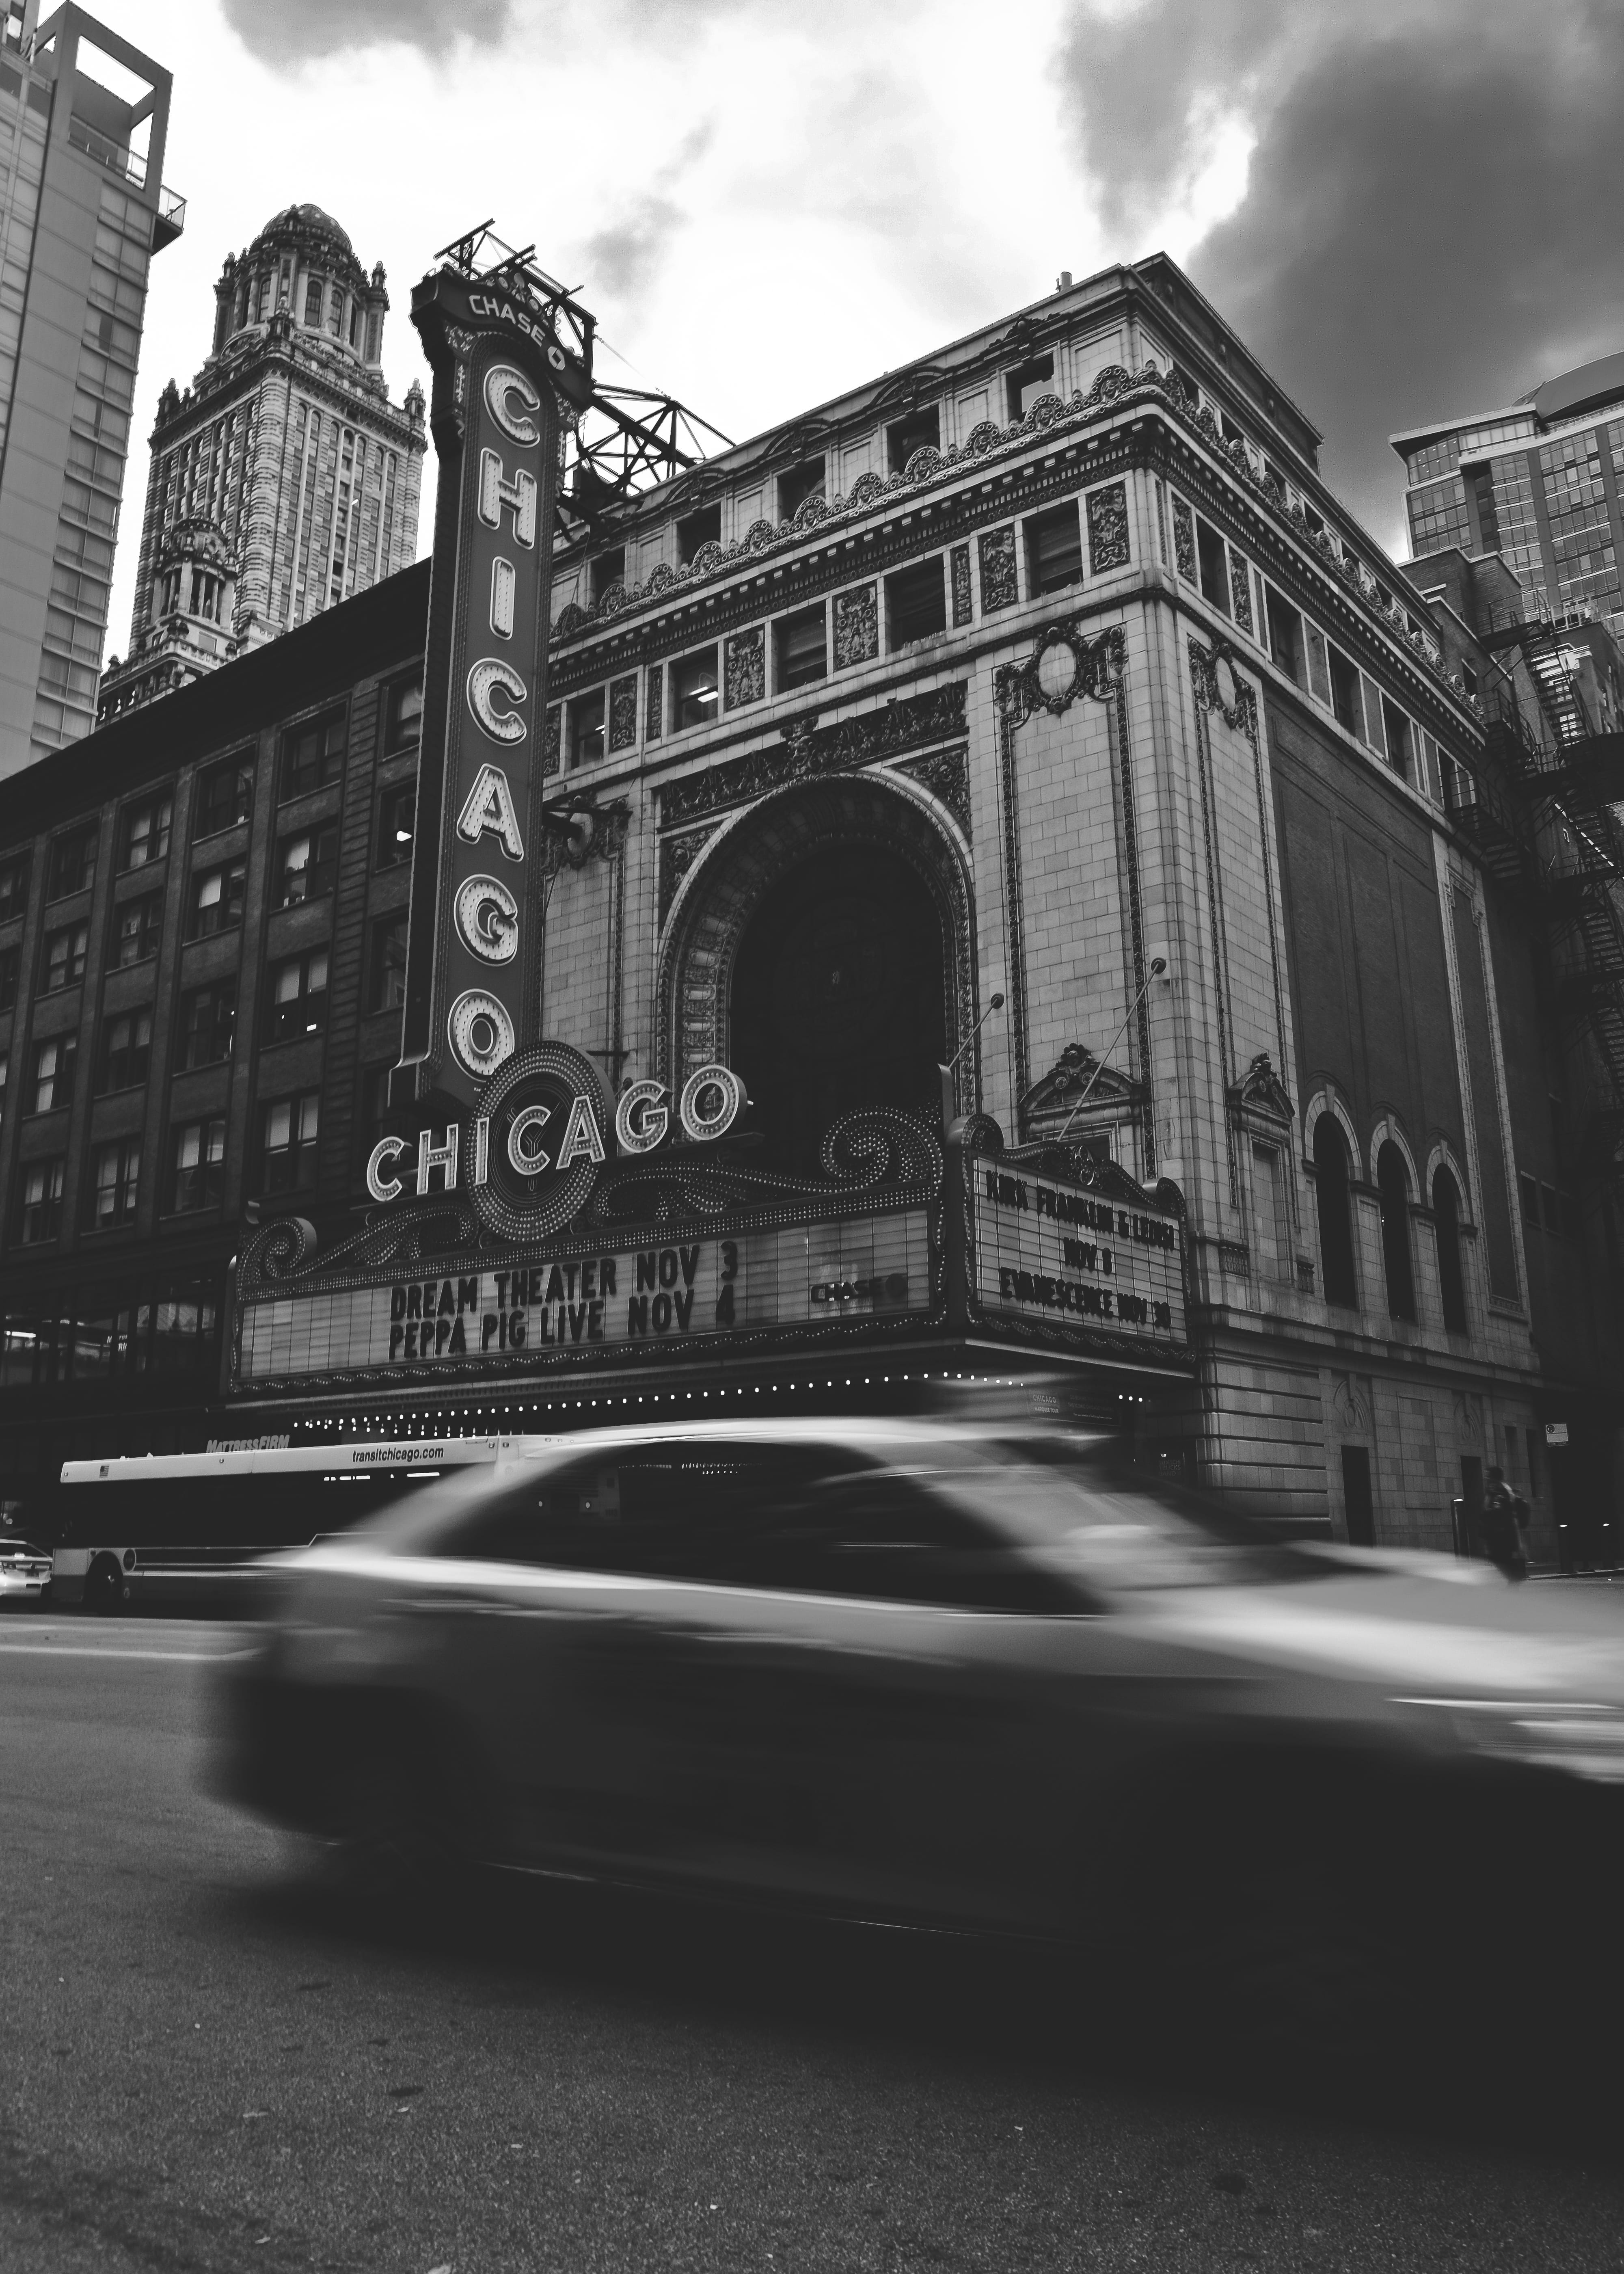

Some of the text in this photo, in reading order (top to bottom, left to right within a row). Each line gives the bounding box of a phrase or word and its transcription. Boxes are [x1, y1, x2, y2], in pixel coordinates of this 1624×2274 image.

[469, 294, 546, 346] CHASE
[447, 364, 540, 1082] CHICAGO
[367, 1064, 741, 1202] CHICAGO
[986, 1169, 1029, 1211] KIRK
[1037, 1185, 1114, 1234] FRANKLIN
[390, 1240, 739, 1321] DREAM THEATER NOV 3
[1063, 1237, 1097, 1271] NOV
[811, 1277, 883, 1303] CHASE
[1000, 1267, 1114, 1318] EVANESCENCE
[1116, 1293, 1148, 1324] NOV
[389, 1284, 736, 1360] PEPPA PIG LIVE NOV 4
[1032, 1394, 1056, 1403] CHICAGO
[352, 1447, 444, 1463] transitchicago.com
